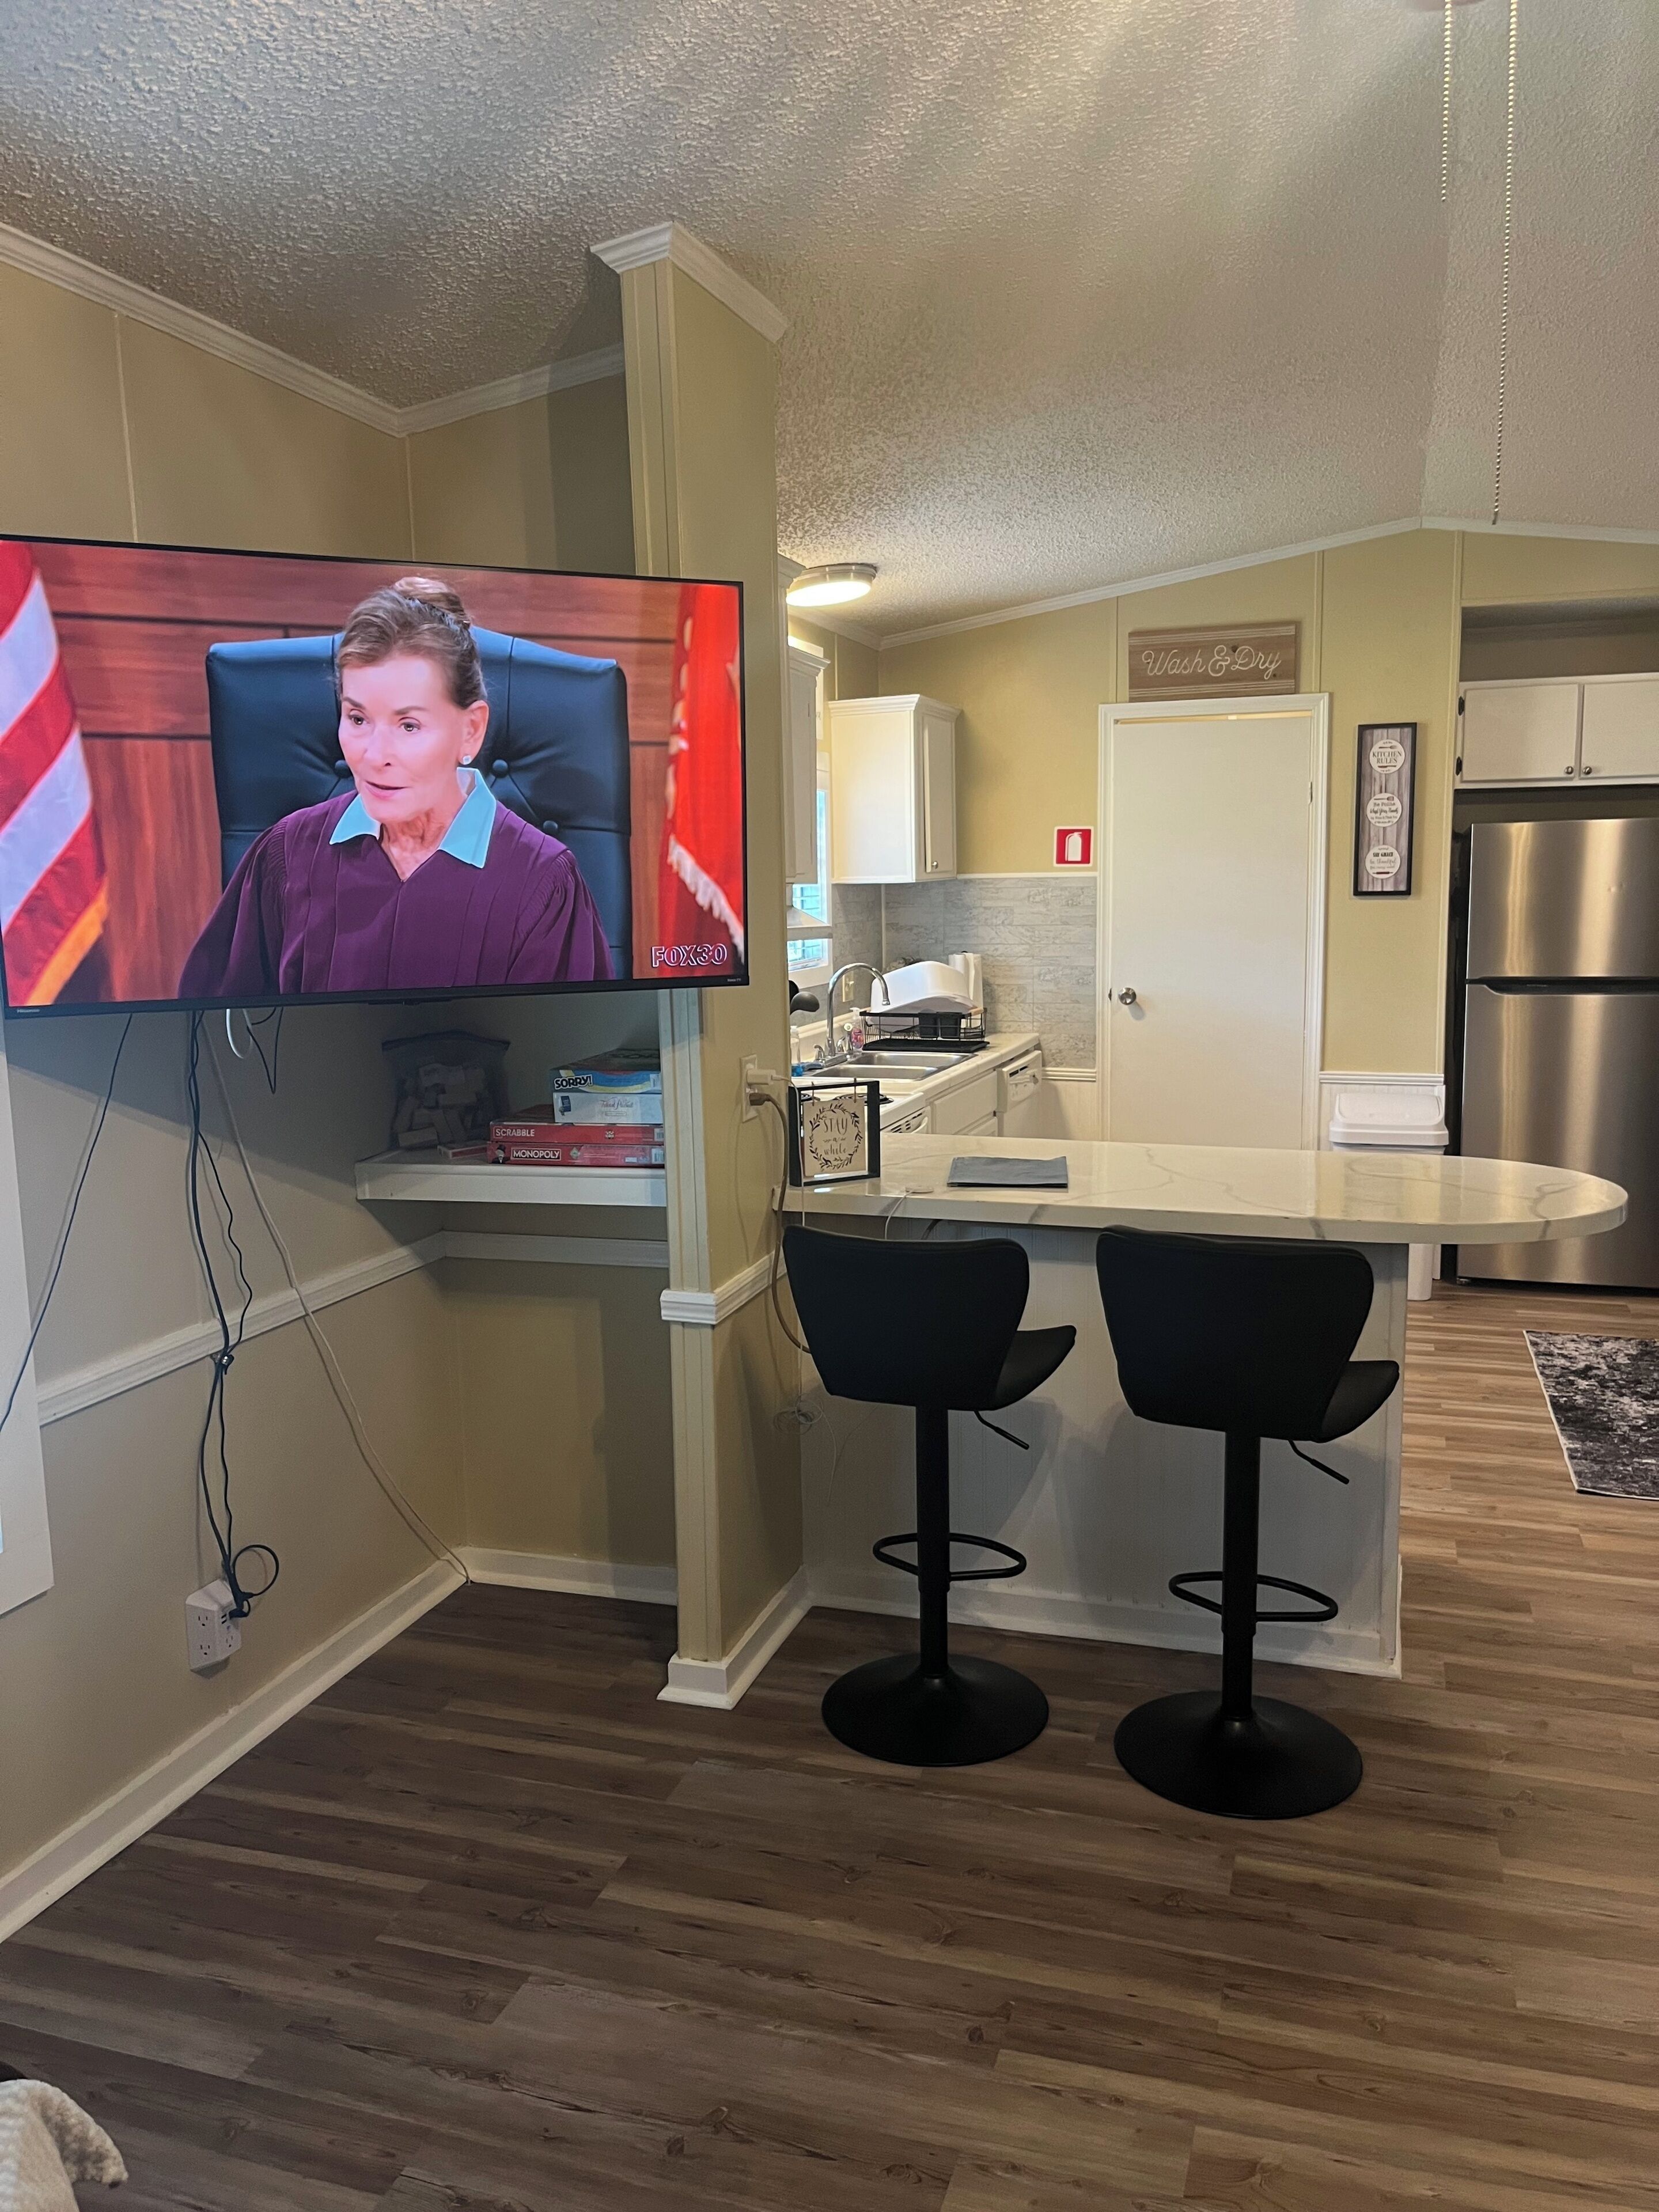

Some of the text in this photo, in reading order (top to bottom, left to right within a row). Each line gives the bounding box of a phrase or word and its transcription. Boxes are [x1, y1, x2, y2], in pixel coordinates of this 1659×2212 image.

[1142, 645, 1282, 680] Wash & Dry
[652, 943, 728, 967] FOX30
[554, 1074, 593, 1090] SORRY!
[495, 1128, 535, 1137] SCRABBLE
[824, 1118, 848, 1135] STAY
[513, 1149, 560, 1160] MONOPOLY
[824, 1143, 846, 1155] while
